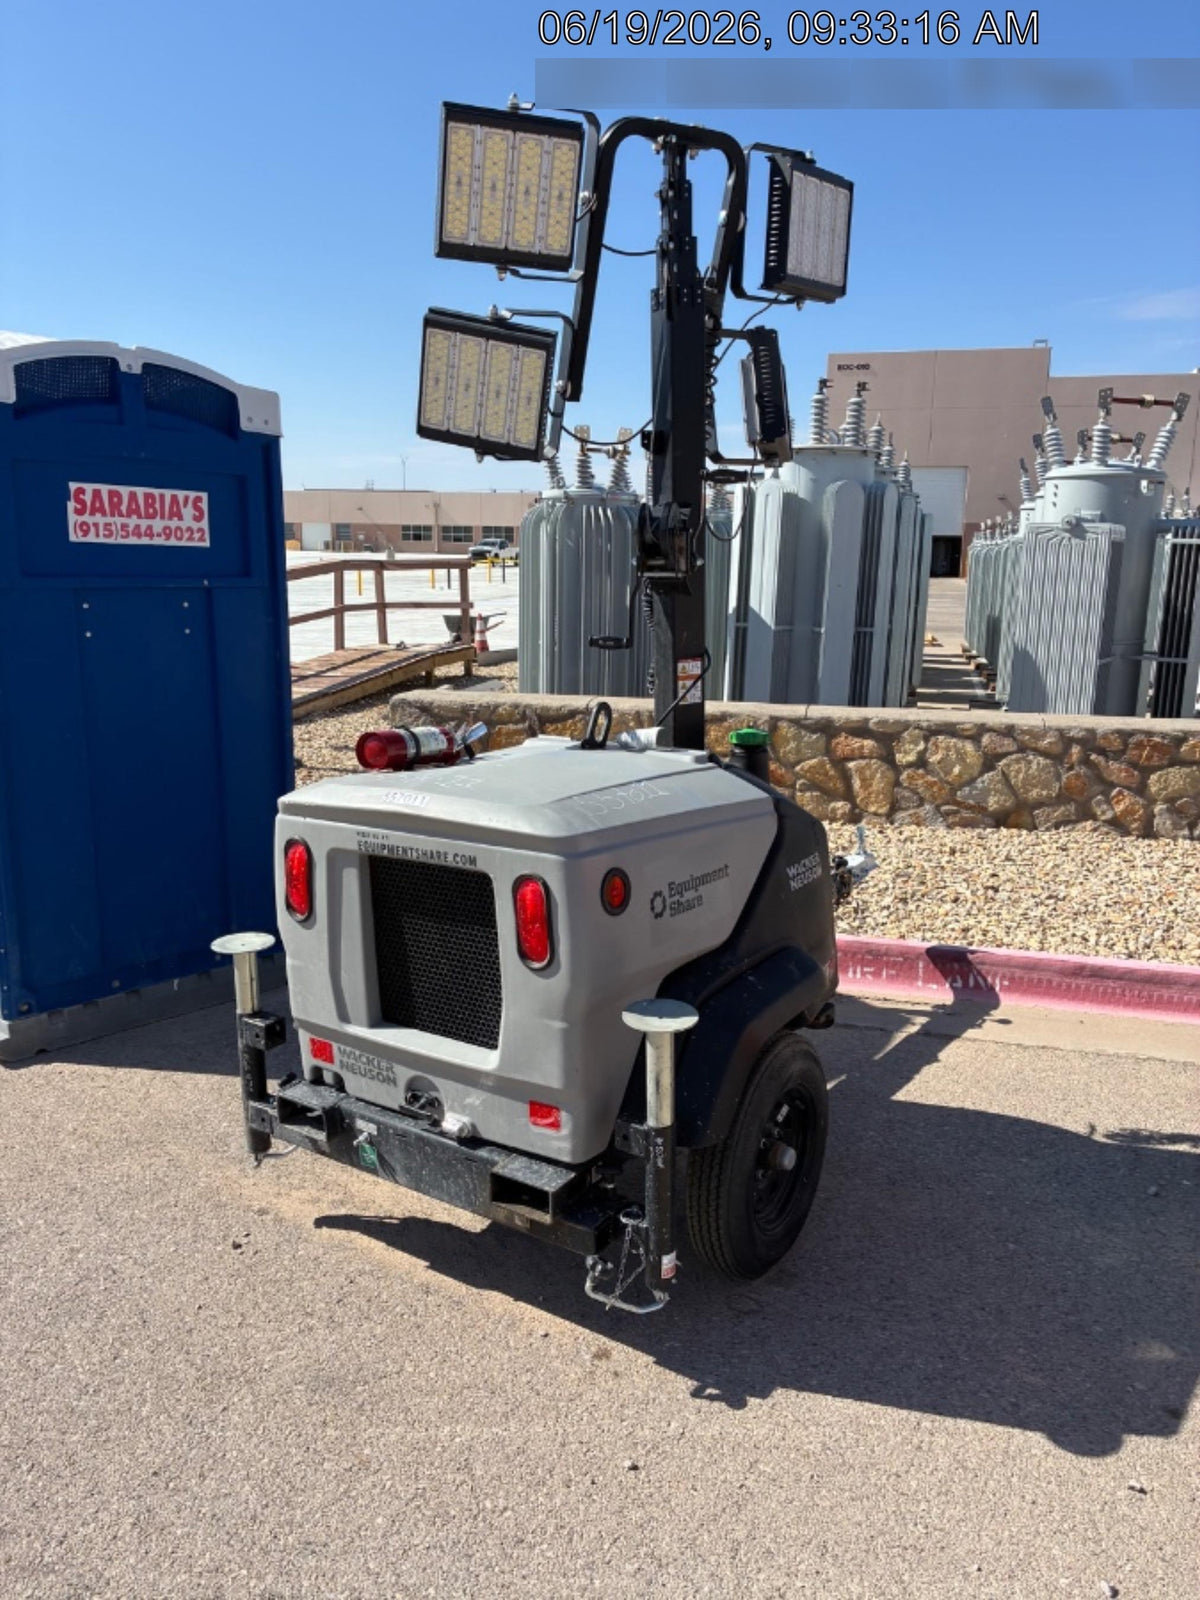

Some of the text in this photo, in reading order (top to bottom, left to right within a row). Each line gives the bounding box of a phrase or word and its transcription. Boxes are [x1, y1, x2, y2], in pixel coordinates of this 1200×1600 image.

[72, 486, 206, 523] SARABIA'S
[73, 519, 207, 543] (915)544-9022
[357, 840, 478, 868] EQUIPMENTSHARE.COM
[667, 863, 730, 899] Equipment
[668, 893, 704, 918] Share
[337, 1046, 397, 1076] WACKER
[339, 1060, 398, 1088] NEUSON
